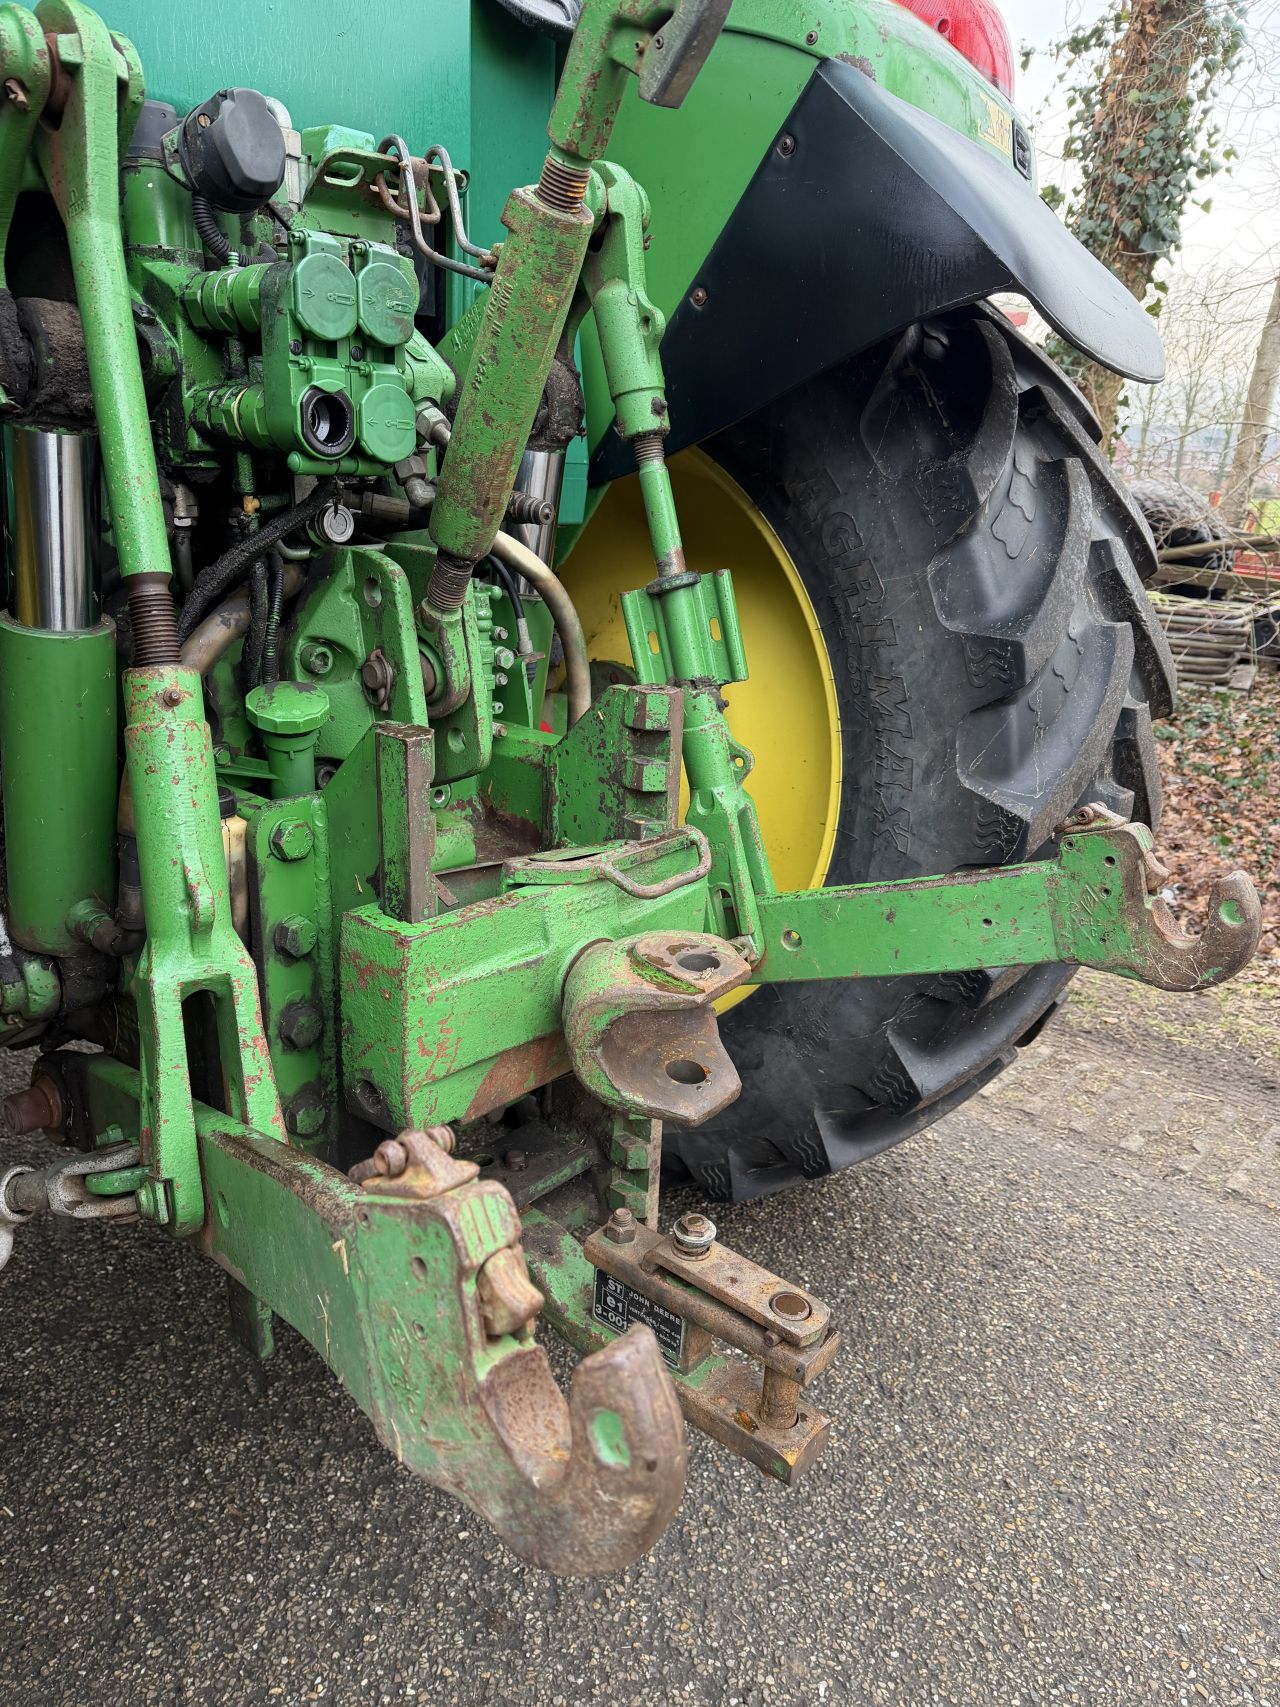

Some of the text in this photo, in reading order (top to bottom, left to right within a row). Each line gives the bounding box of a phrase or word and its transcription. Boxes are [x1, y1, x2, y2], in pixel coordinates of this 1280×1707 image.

[607, 1279, 623, 1294] ST
[606, 1296, 623, 1313] e1
[628, 1291, 650, 1307] JOHN
[653, 1305, 681, 1326] DEERE
